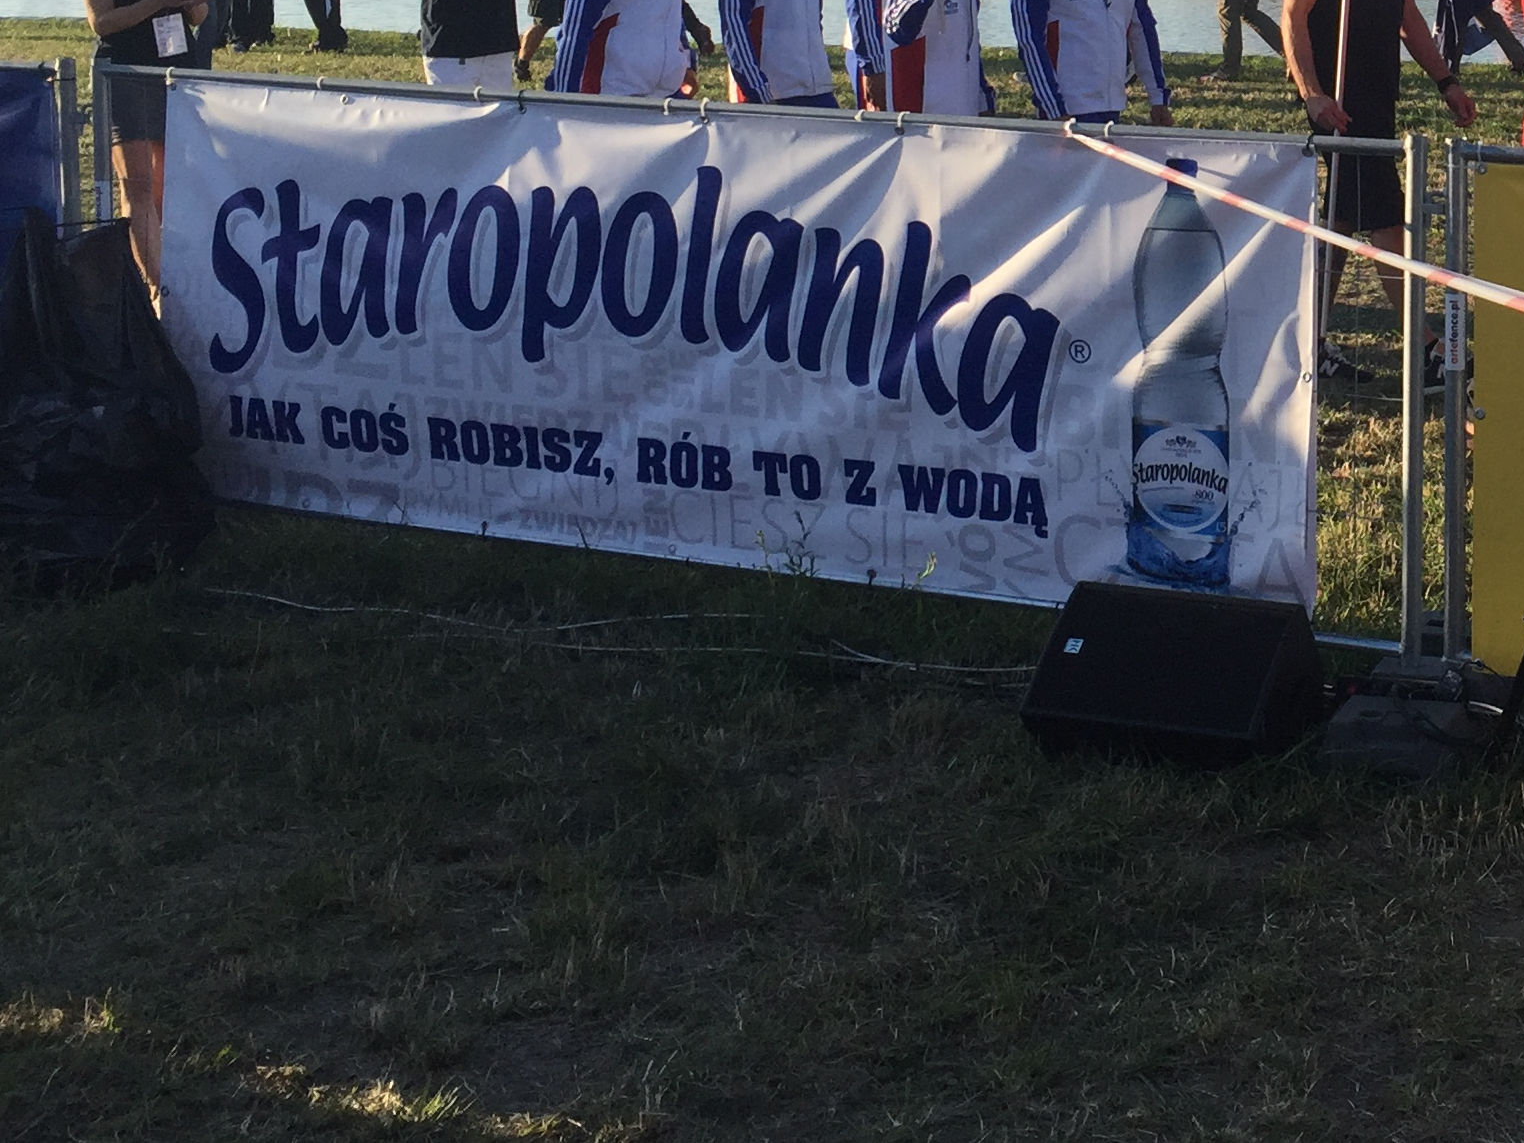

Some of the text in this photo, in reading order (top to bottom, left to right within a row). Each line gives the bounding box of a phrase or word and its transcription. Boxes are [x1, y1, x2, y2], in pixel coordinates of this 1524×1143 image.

[208, 165, 1062, 452] Staropolanka
[229, 395, 305, 444] JAK
[321, 402, 409, 456] COŚ
[427, 416, 615, 486] ROBISZ,
[636, 432, 734, 492] RÓB
[752, 450, 822, 501] TO
[844, 459, 877, 506] Z
[898, 463, 1049, 539] WODĄ
[1132, 461, 1229, 495] Staropolanka
